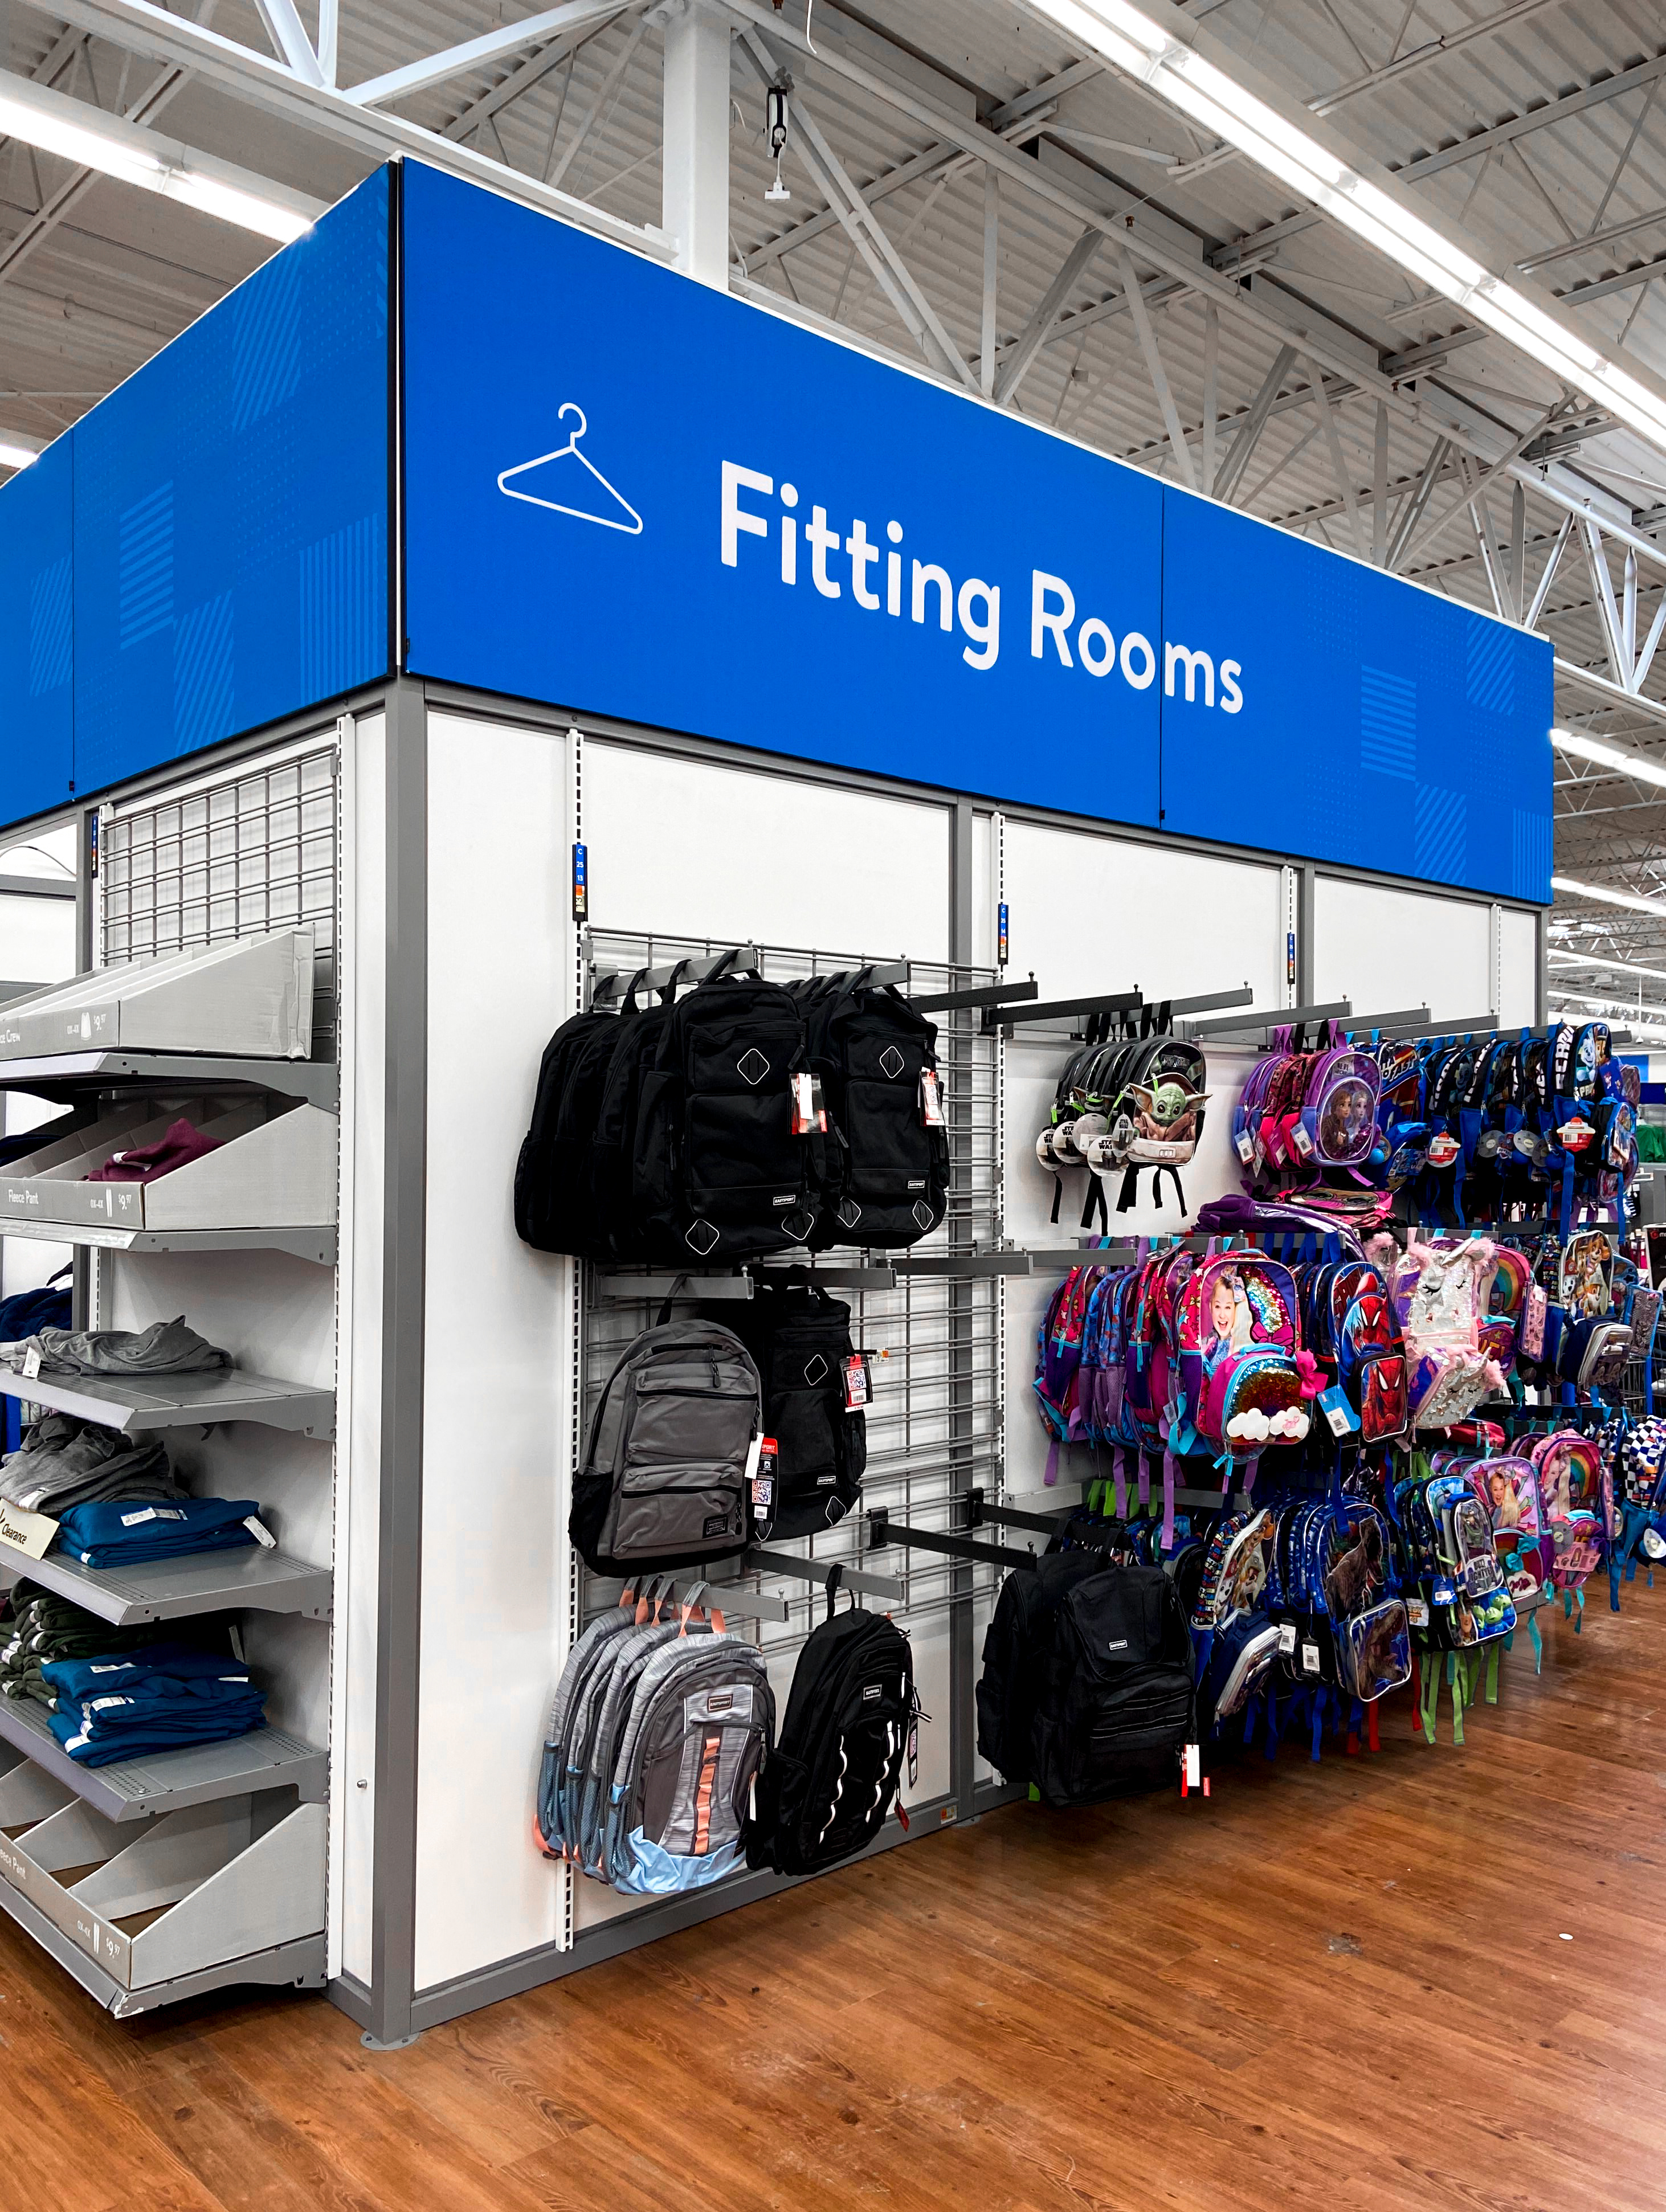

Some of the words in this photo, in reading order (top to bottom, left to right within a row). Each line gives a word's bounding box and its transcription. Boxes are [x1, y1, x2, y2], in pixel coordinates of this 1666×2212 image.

[722, 460, 1000, 670] Fitting
[1031, 569, 1243, 713] Rooms
[6, 1029, 21, 1043] Crew
[8, 1189, 24, 1204] Fleece
[26, 1190, 39, 1204] Pant
[118, 1193, 132, 1210] $9.97
[2, 1523, 27, 1544] Clearance
[13, 1857, 26, 1879] Pant
